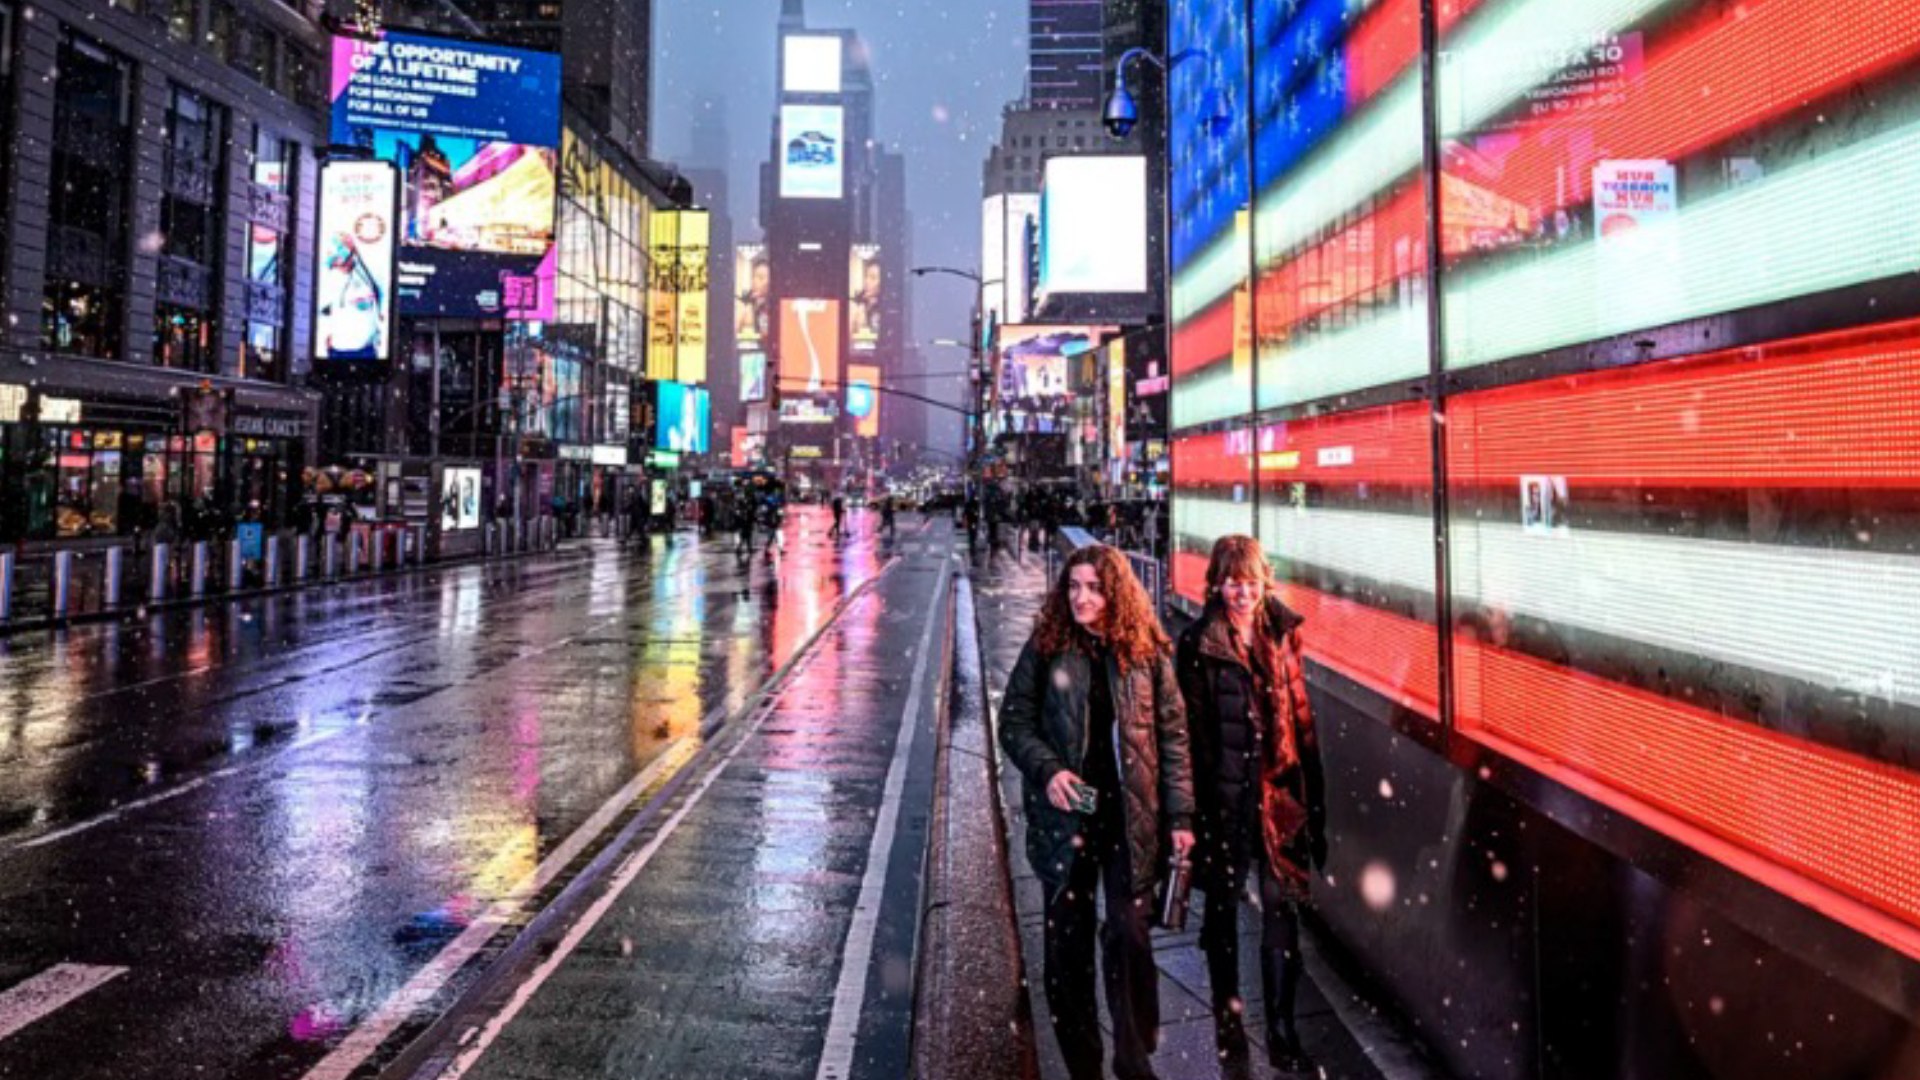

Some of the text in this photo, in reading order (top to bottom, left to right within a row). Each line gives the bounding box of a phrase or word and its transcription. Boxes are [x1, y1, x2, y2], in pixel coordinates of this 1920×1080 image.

[350, 54, 478, 83] OF A LIFETIME
[354, 40, 522, 73] THE OPPORTUNITY
[348, 85, 434, 104] FOR BROADWAY
[349, 72, 477, 97] FOR LOCAL BUSINESSES
[347, 99, 428, 118] FOR ALL OF US
